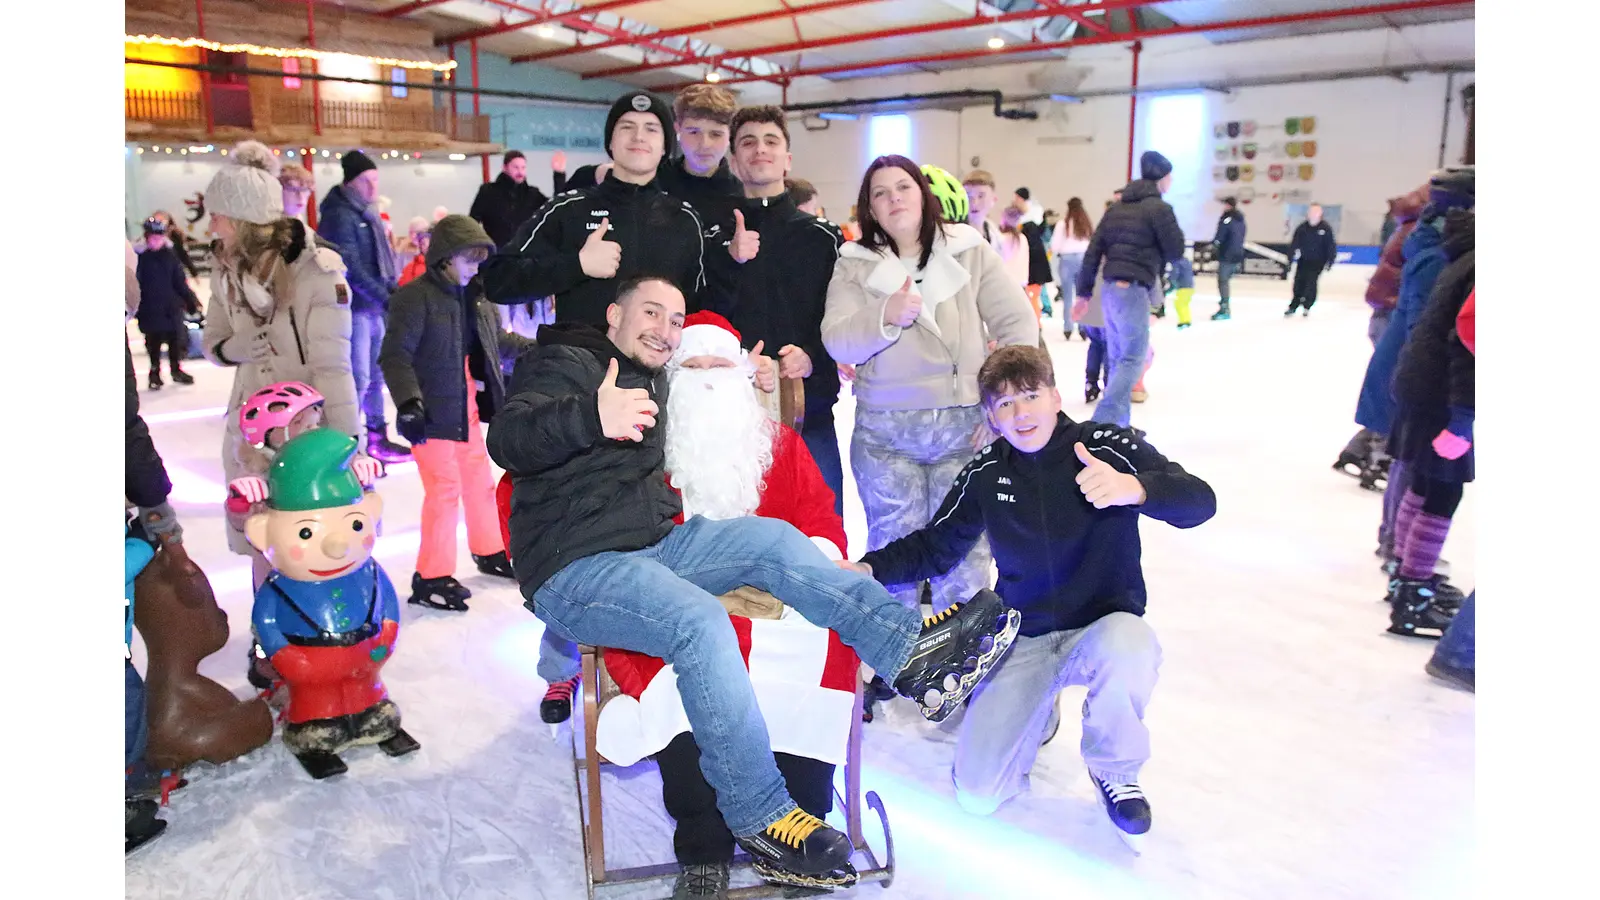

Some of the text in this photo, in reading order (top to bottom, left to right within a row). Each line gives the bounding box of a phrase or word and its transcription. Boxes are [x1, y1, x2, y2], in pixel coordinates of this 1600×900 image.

[997, 492, 1009, 502] TIM
[919, 632, 952, 651] BAUER
[754, 838, 782, 860] BAUER
